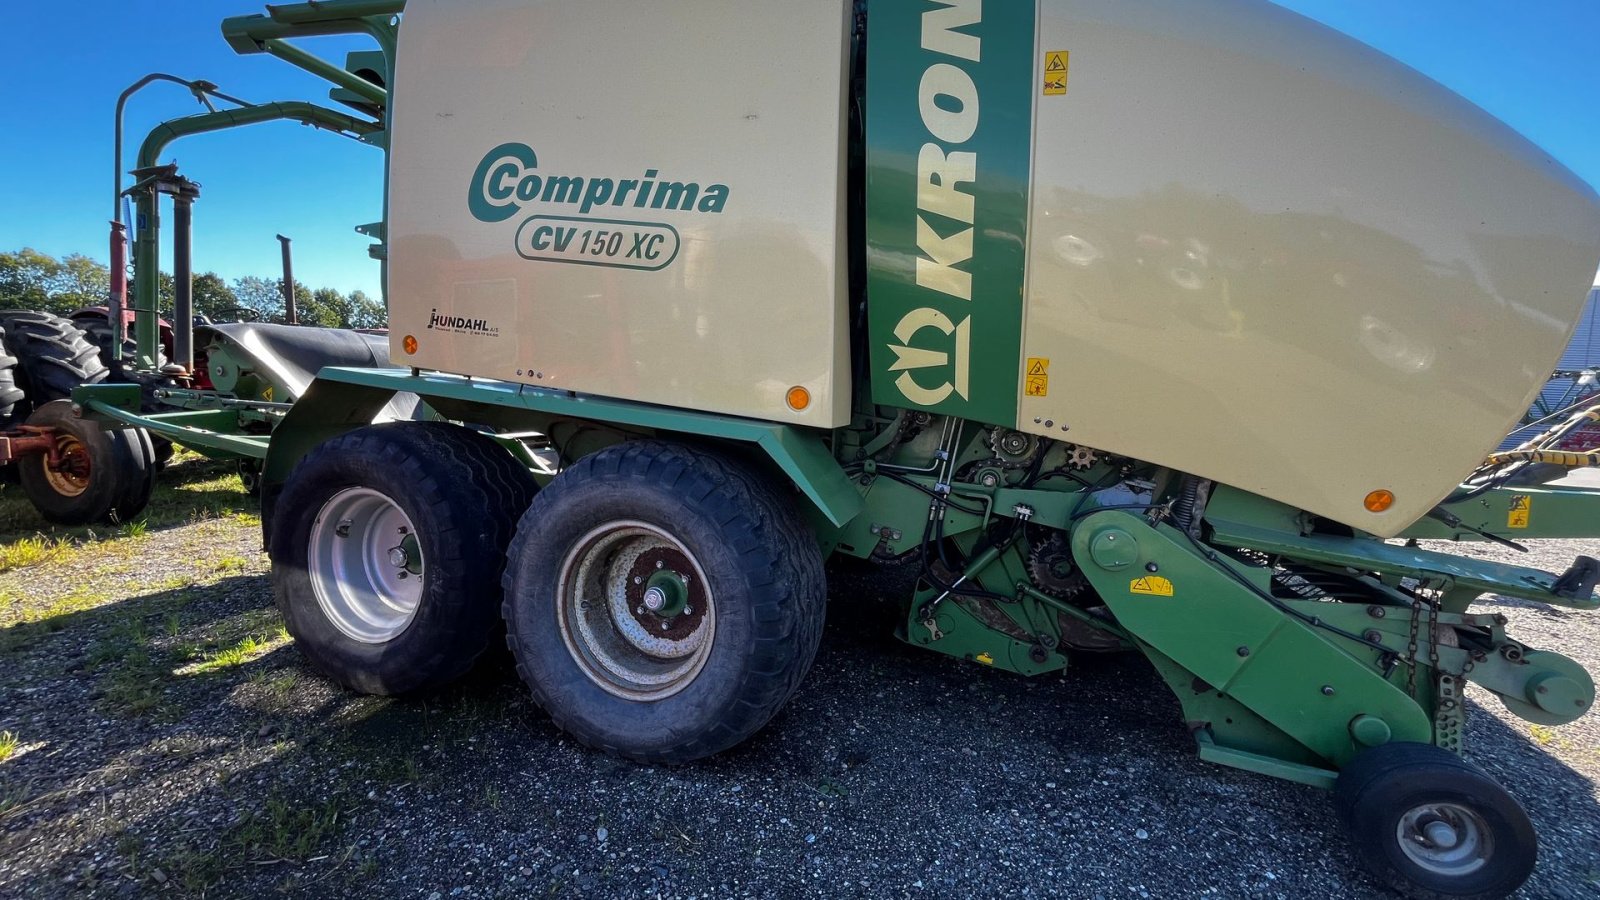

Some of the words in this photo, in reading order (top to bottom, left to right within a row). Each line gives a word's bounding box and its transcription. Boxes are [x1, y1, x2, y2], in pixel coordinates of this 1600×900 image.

[468, 142, 730, 223] Comprima
[531, 225, 577, 252] CV
[580, 230, 623, 257] 150
[626, 233, 664, 260] XC
